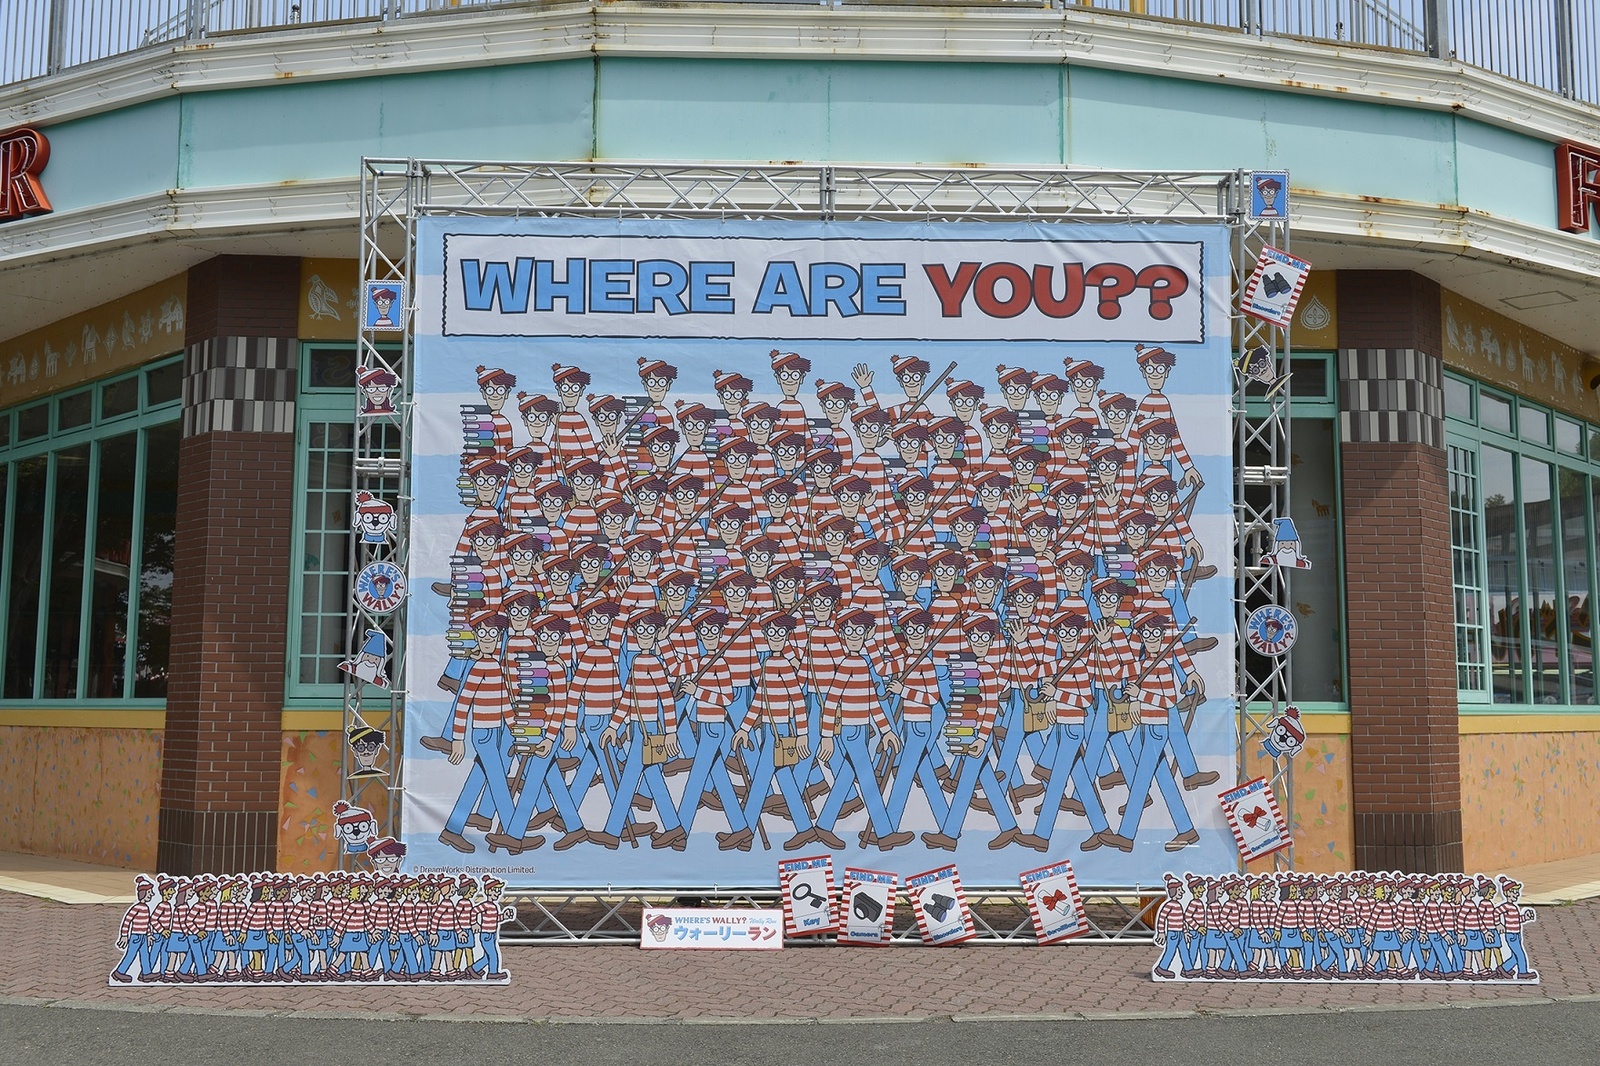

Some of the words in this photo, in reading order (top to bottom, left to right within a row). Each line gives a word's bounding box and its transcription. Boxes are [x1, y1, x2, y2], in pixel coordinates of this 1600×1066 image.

[1266, 249, 1290, 264] FIND
[1291, 260, 1307, 271] ME
[460, 256, 735, 316] WHERE
[752, 261, 906, 318] ARE
[922, 261, 1189, 320] YOU??
[358, 564, 401, 593] WHERE'S
[362, 583, 404, 611] WALLY?
[1248, 608, 1294, 631] WHERE'S
[1249, 631, 1294, 654] WALLY?
[1224, 788, 1247, 803] FIND
[1248, 780, 1265, 792] ME
[420, 866, 464, 874] DreamWorks
[465, 866, 507, 874] Distribution
[507, 866, 536, 874] Limited.
[784, 861, 808, 872] FIND
[812, 858, 828, 868] ME
[1025, 870, 1050, 883] FIND
[1052, 864, 1068, 876] ME
[849, 871, 874, 882] FIND
[877, 875, 894, 884] ME
[911, 874, 936, 888] FIND
[938, 868, 954, 879] ME
[673, 925, 777, 941] ウォーリーラン
[803, 918, 820, 927] Key
